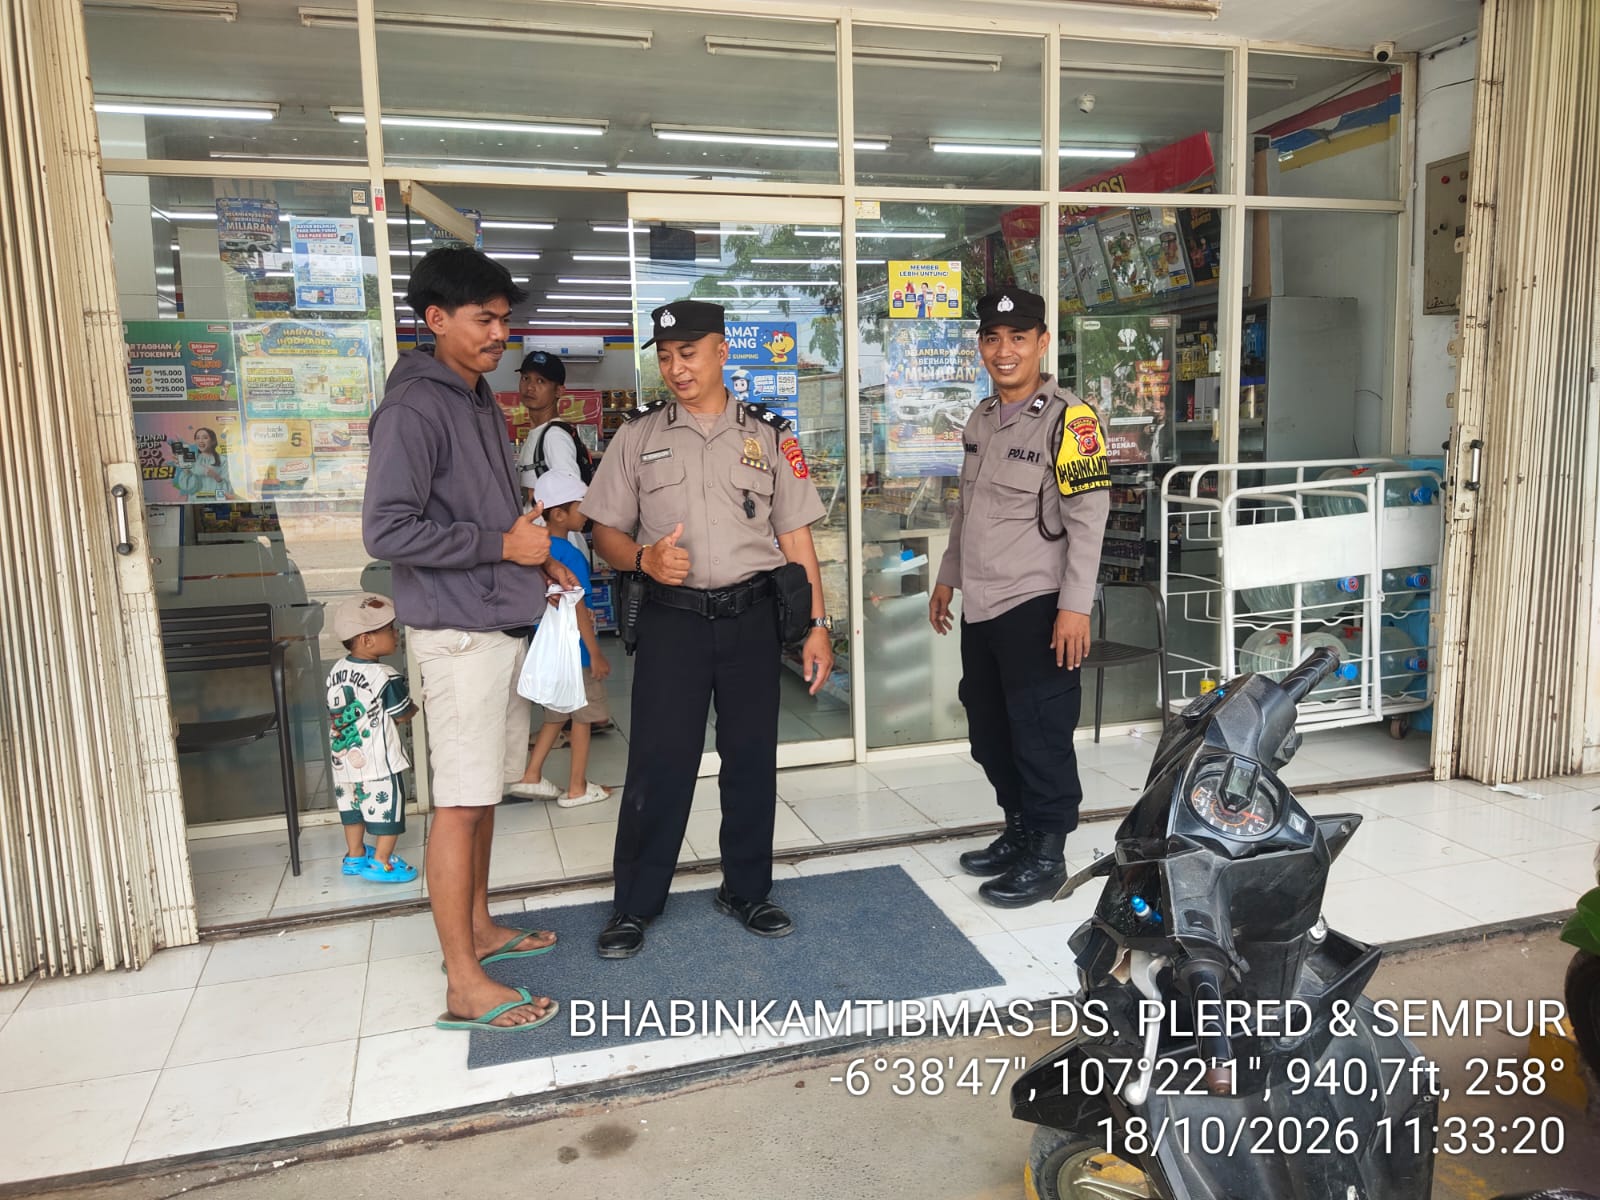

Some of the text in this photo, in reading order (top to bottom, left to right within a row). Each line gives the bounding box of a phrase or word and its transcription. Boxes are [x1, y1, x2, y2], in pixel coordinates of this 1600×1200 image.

[226, 222, 273, 233] MILIARAN
[283, 328, 313, 336] HANYA
[277, 337, 332, 345] INDOMARET
[1008, 448, 1041, 463] POLRI
[143, 465, 175, 479] TIS!
